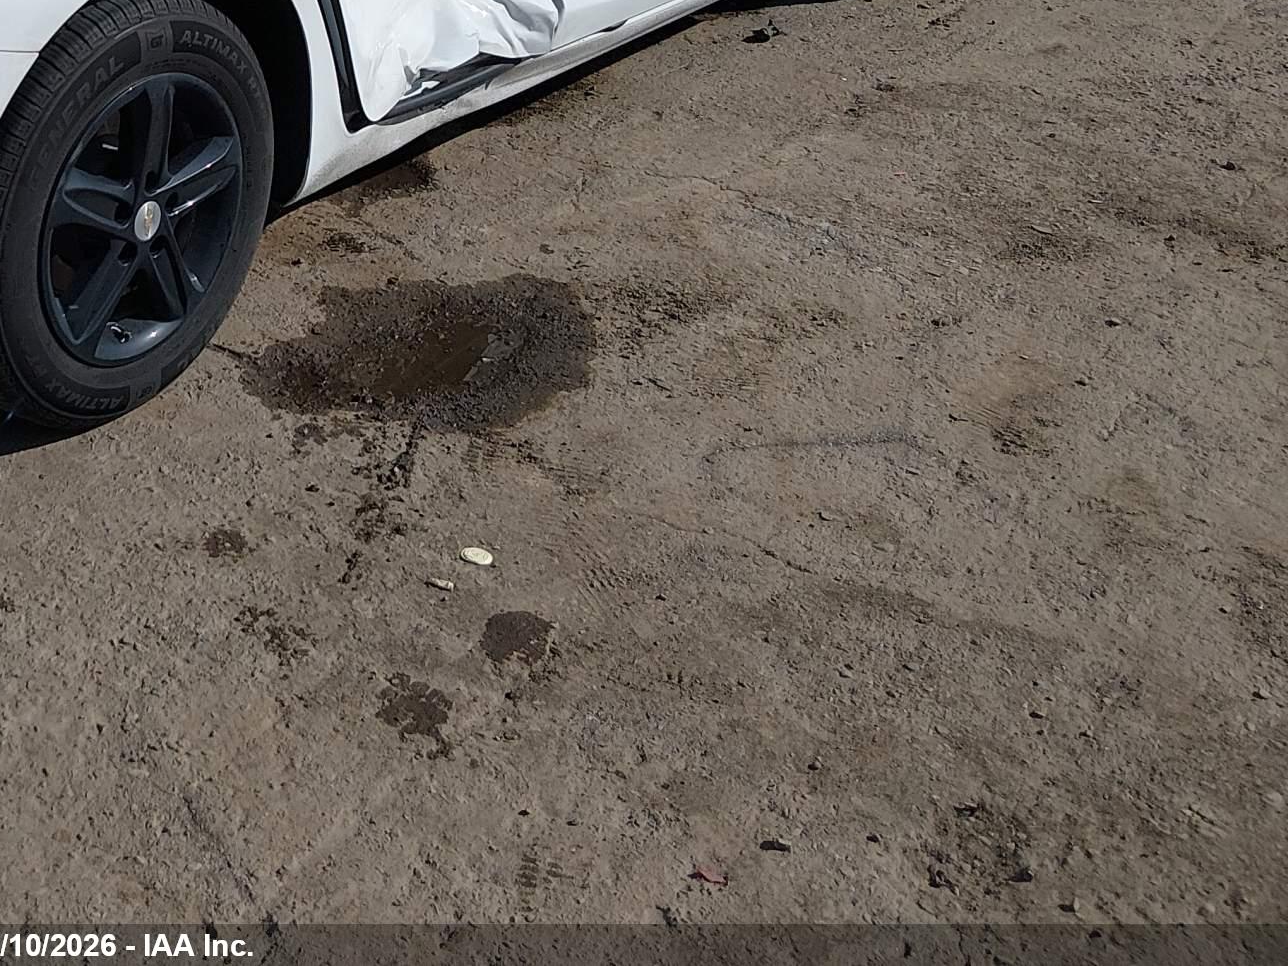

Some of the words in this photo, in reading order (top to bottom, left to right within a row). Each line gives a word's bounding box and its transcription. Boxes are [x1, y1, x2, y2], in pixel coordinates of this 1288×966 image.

[179, 30, 249, 74] ALTIMAX
[30, 56, 125, 188] GENERAL
[44, 378, 124, 411] ALTIMAX
